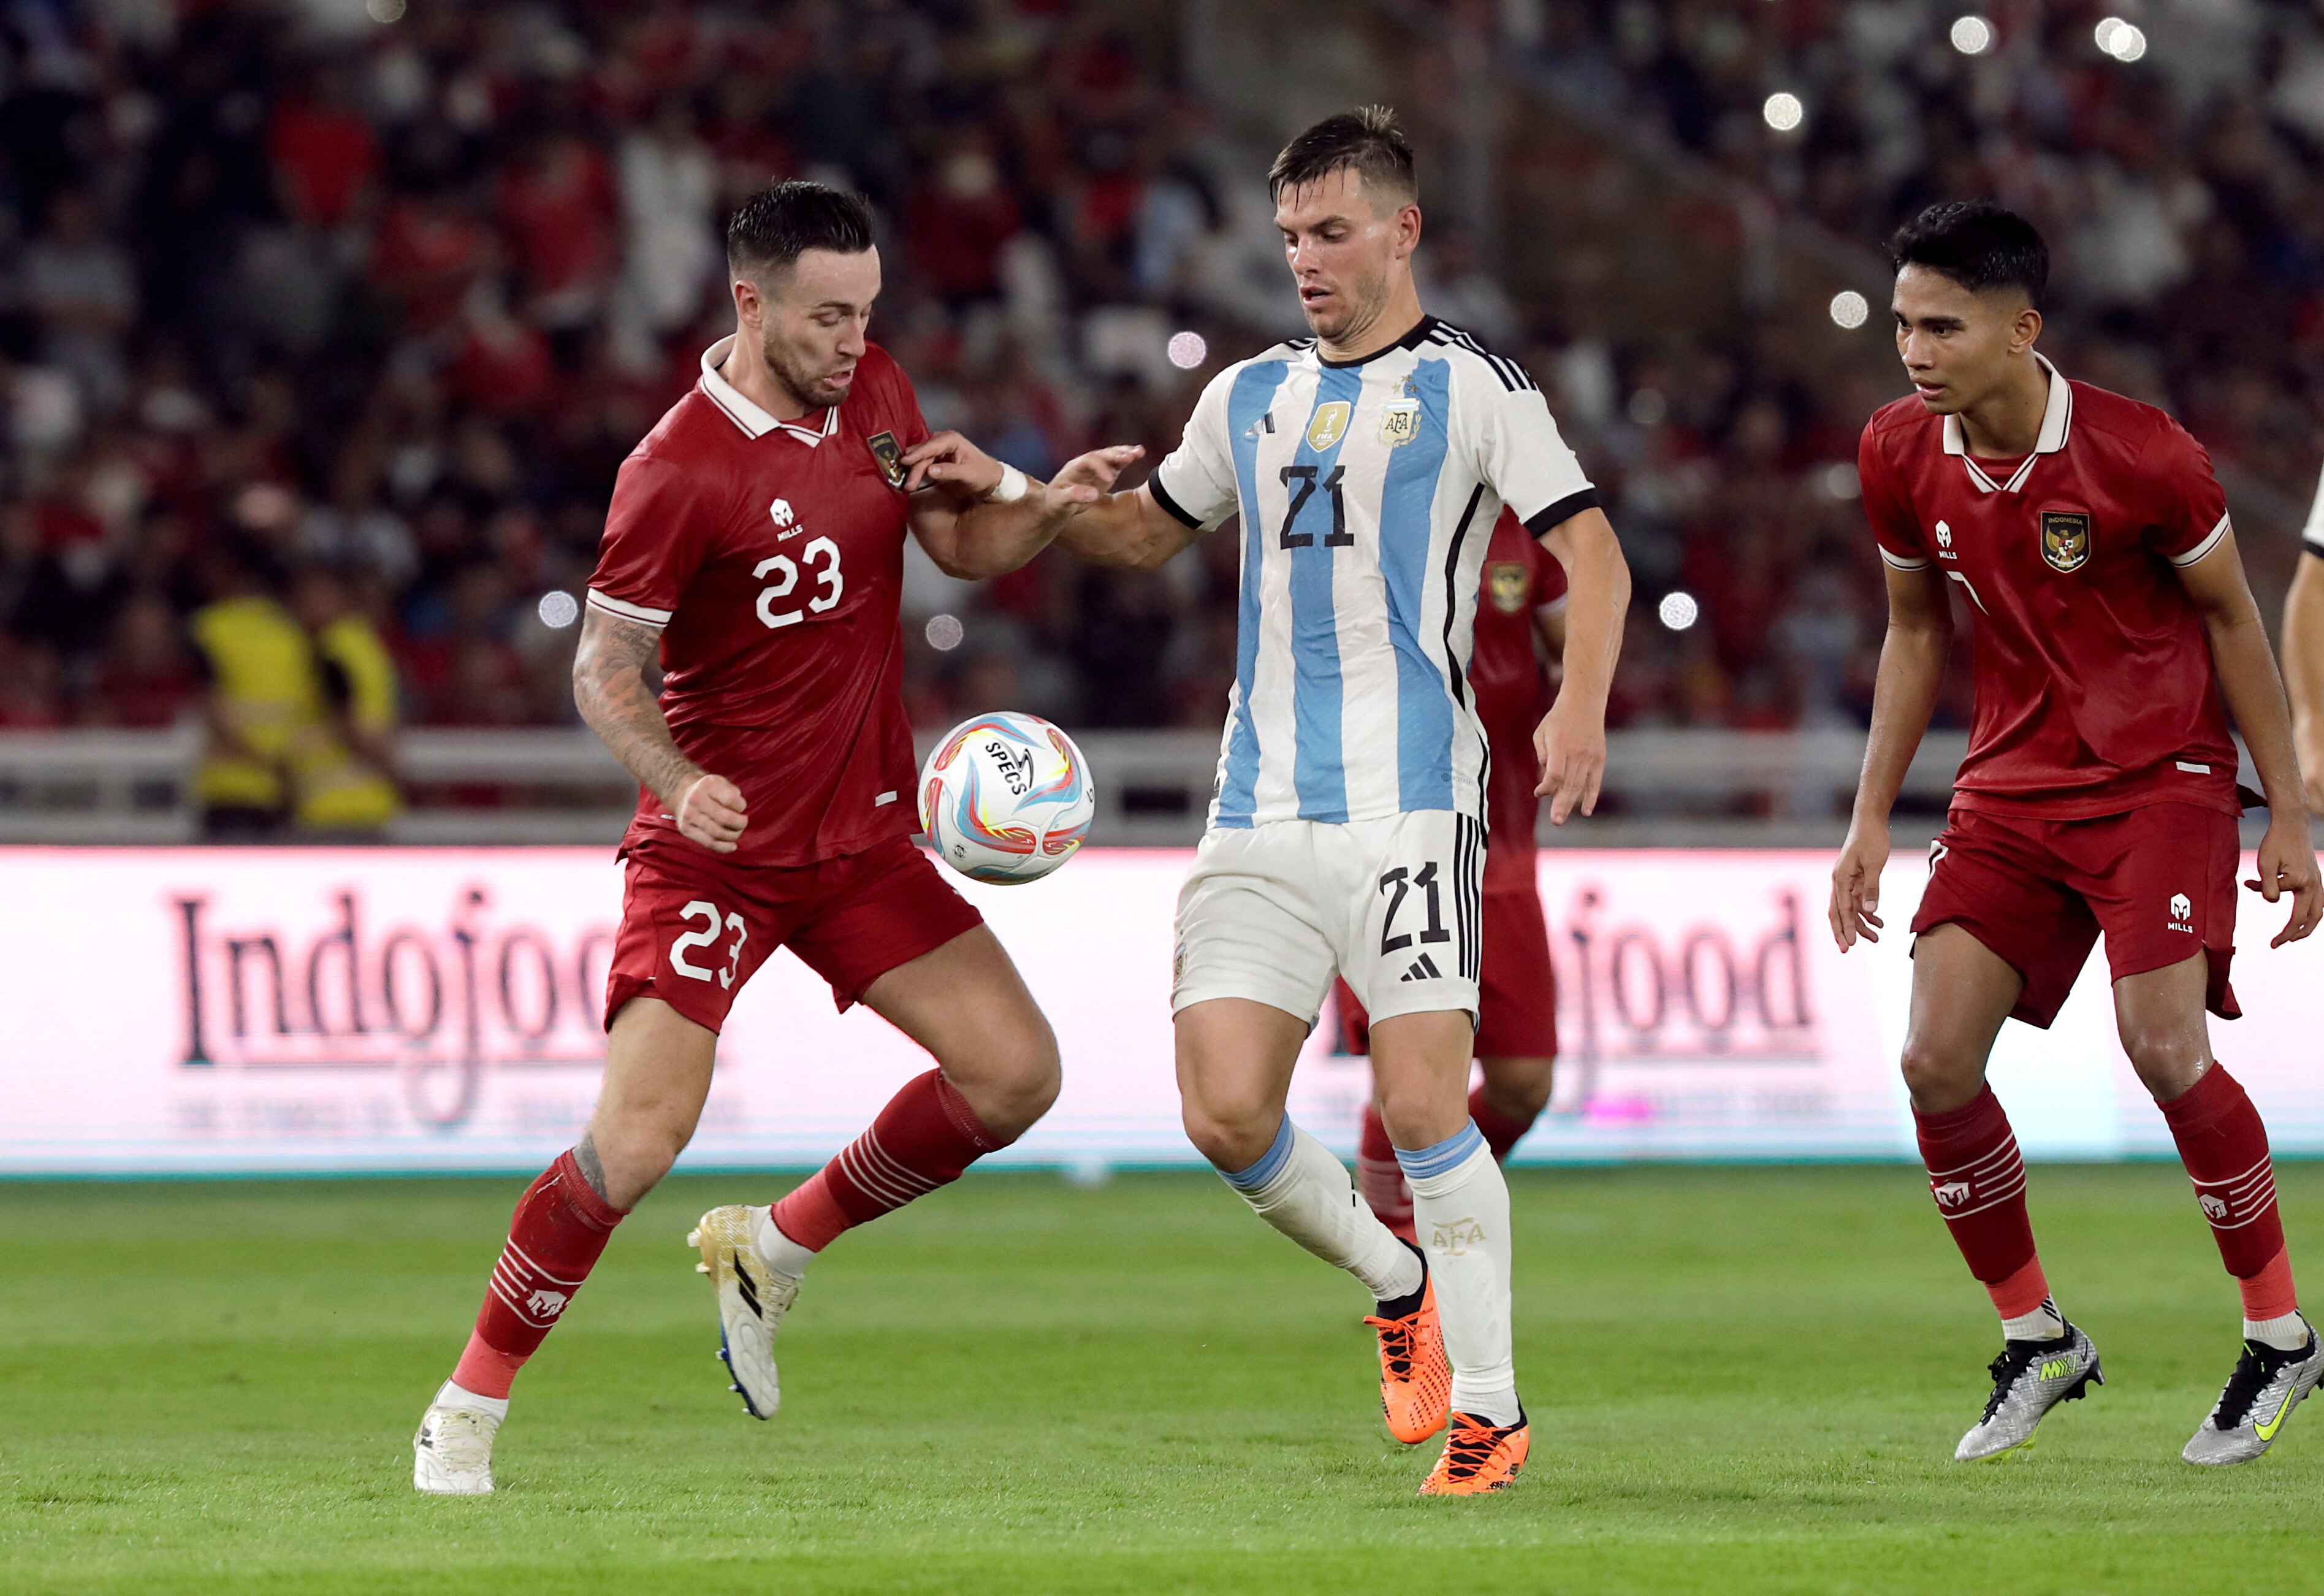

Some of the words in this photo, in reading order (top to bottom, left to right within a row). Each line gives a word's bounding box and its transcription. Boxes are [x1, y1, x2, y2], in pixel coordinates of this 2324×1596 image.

[1385, 411, 1408, 433] AFA
[1279, 465, 1354, 549] 21
[2048, 516, 2083, 525] INDONESIA
[777, 524, 804, 542] MILLS
[1938, 551, 1957, 560] MILLS
[752, 536, 844, 628] 23
[985, 742, 1027, 796] SPECS
[1379, 861, 1450, 957] 21
[2168, 922, 2193, 933] MILLS
[669, 900, 748, 991] 23
[1432, 1216, 1487, 1256] AFA
